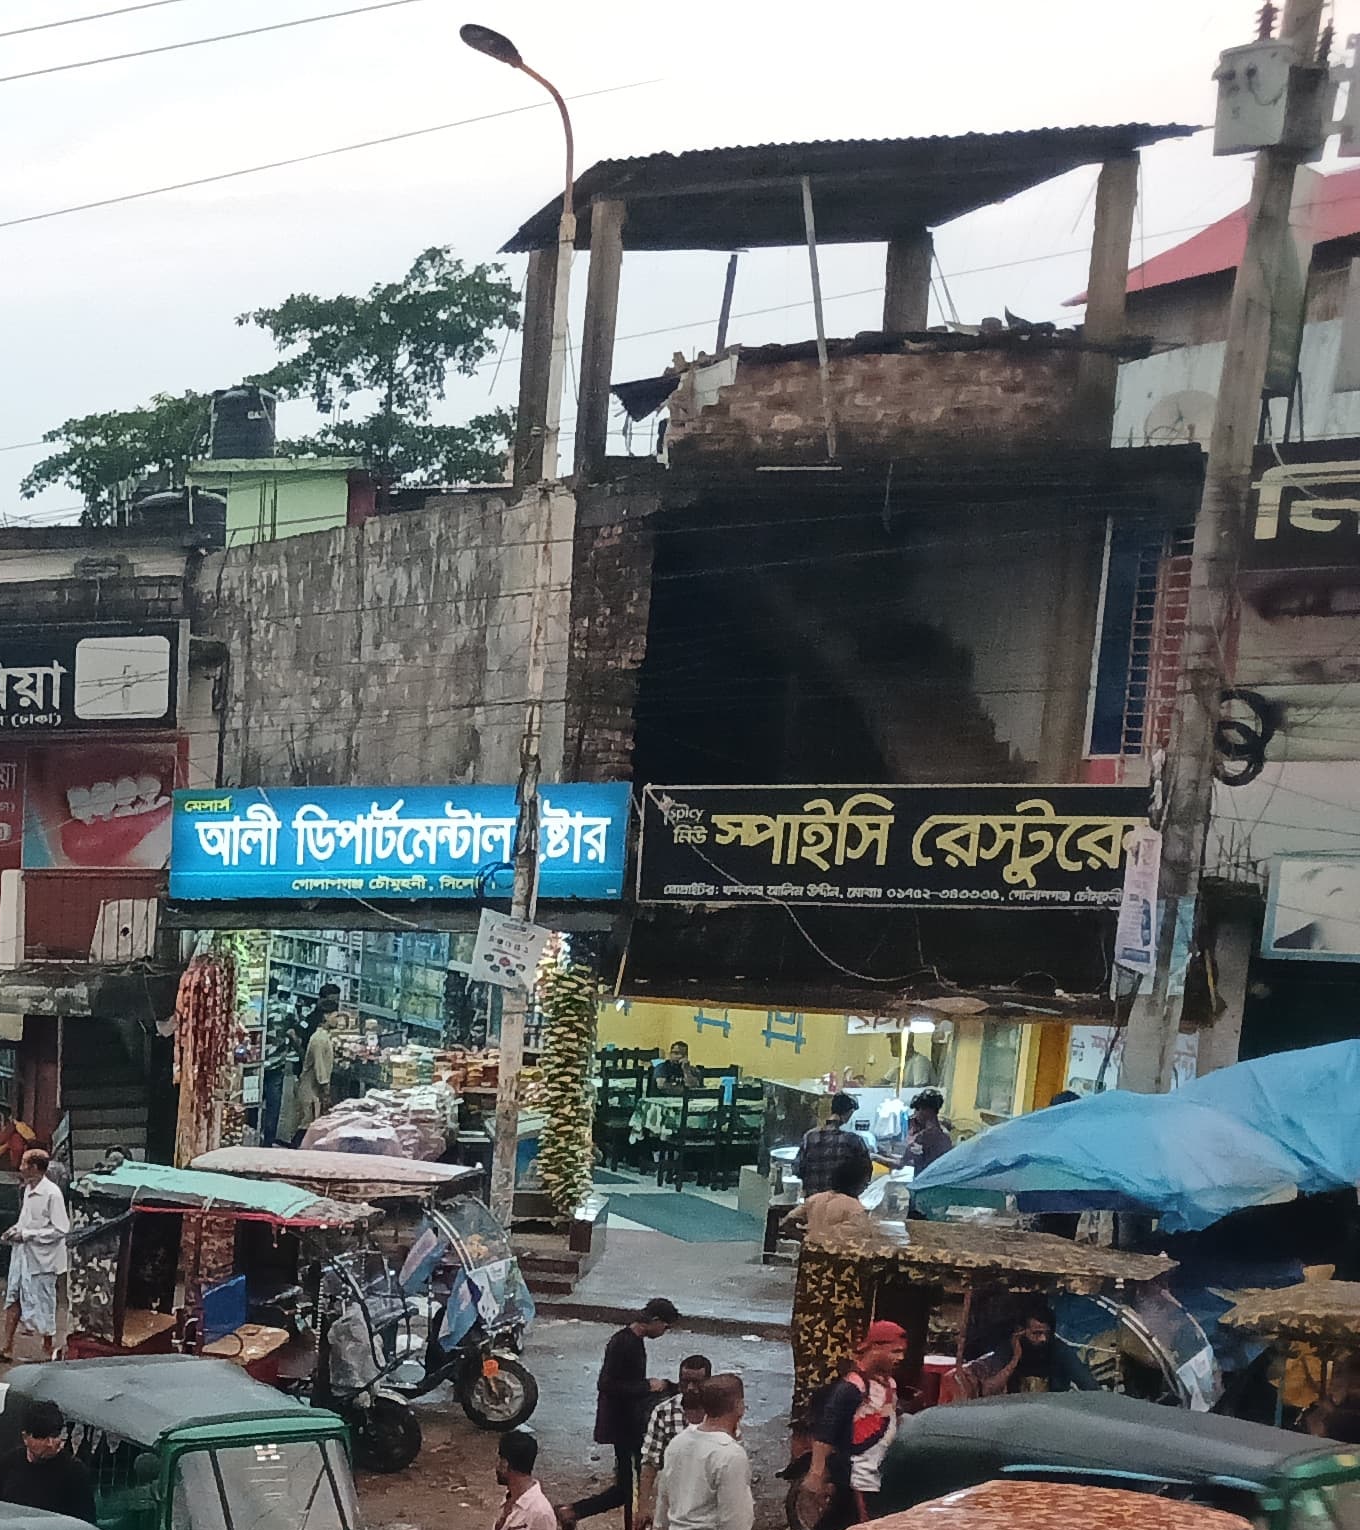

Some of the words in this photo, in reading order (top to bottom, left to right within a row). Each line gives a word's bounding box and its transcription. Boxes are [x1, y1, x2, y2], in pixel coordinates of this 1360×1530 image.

[184, 795, 232, 813] মেসার্স
[195, 803, 282, 867] আলী
[292, 799, 516, 867] ডিপার্টমেন্টাল
[672, 824, 709, 844] নিউ
[712, 793, 895, 871] স্পাইসি
[912, 797, 1151, 888] রেস্টুরে
